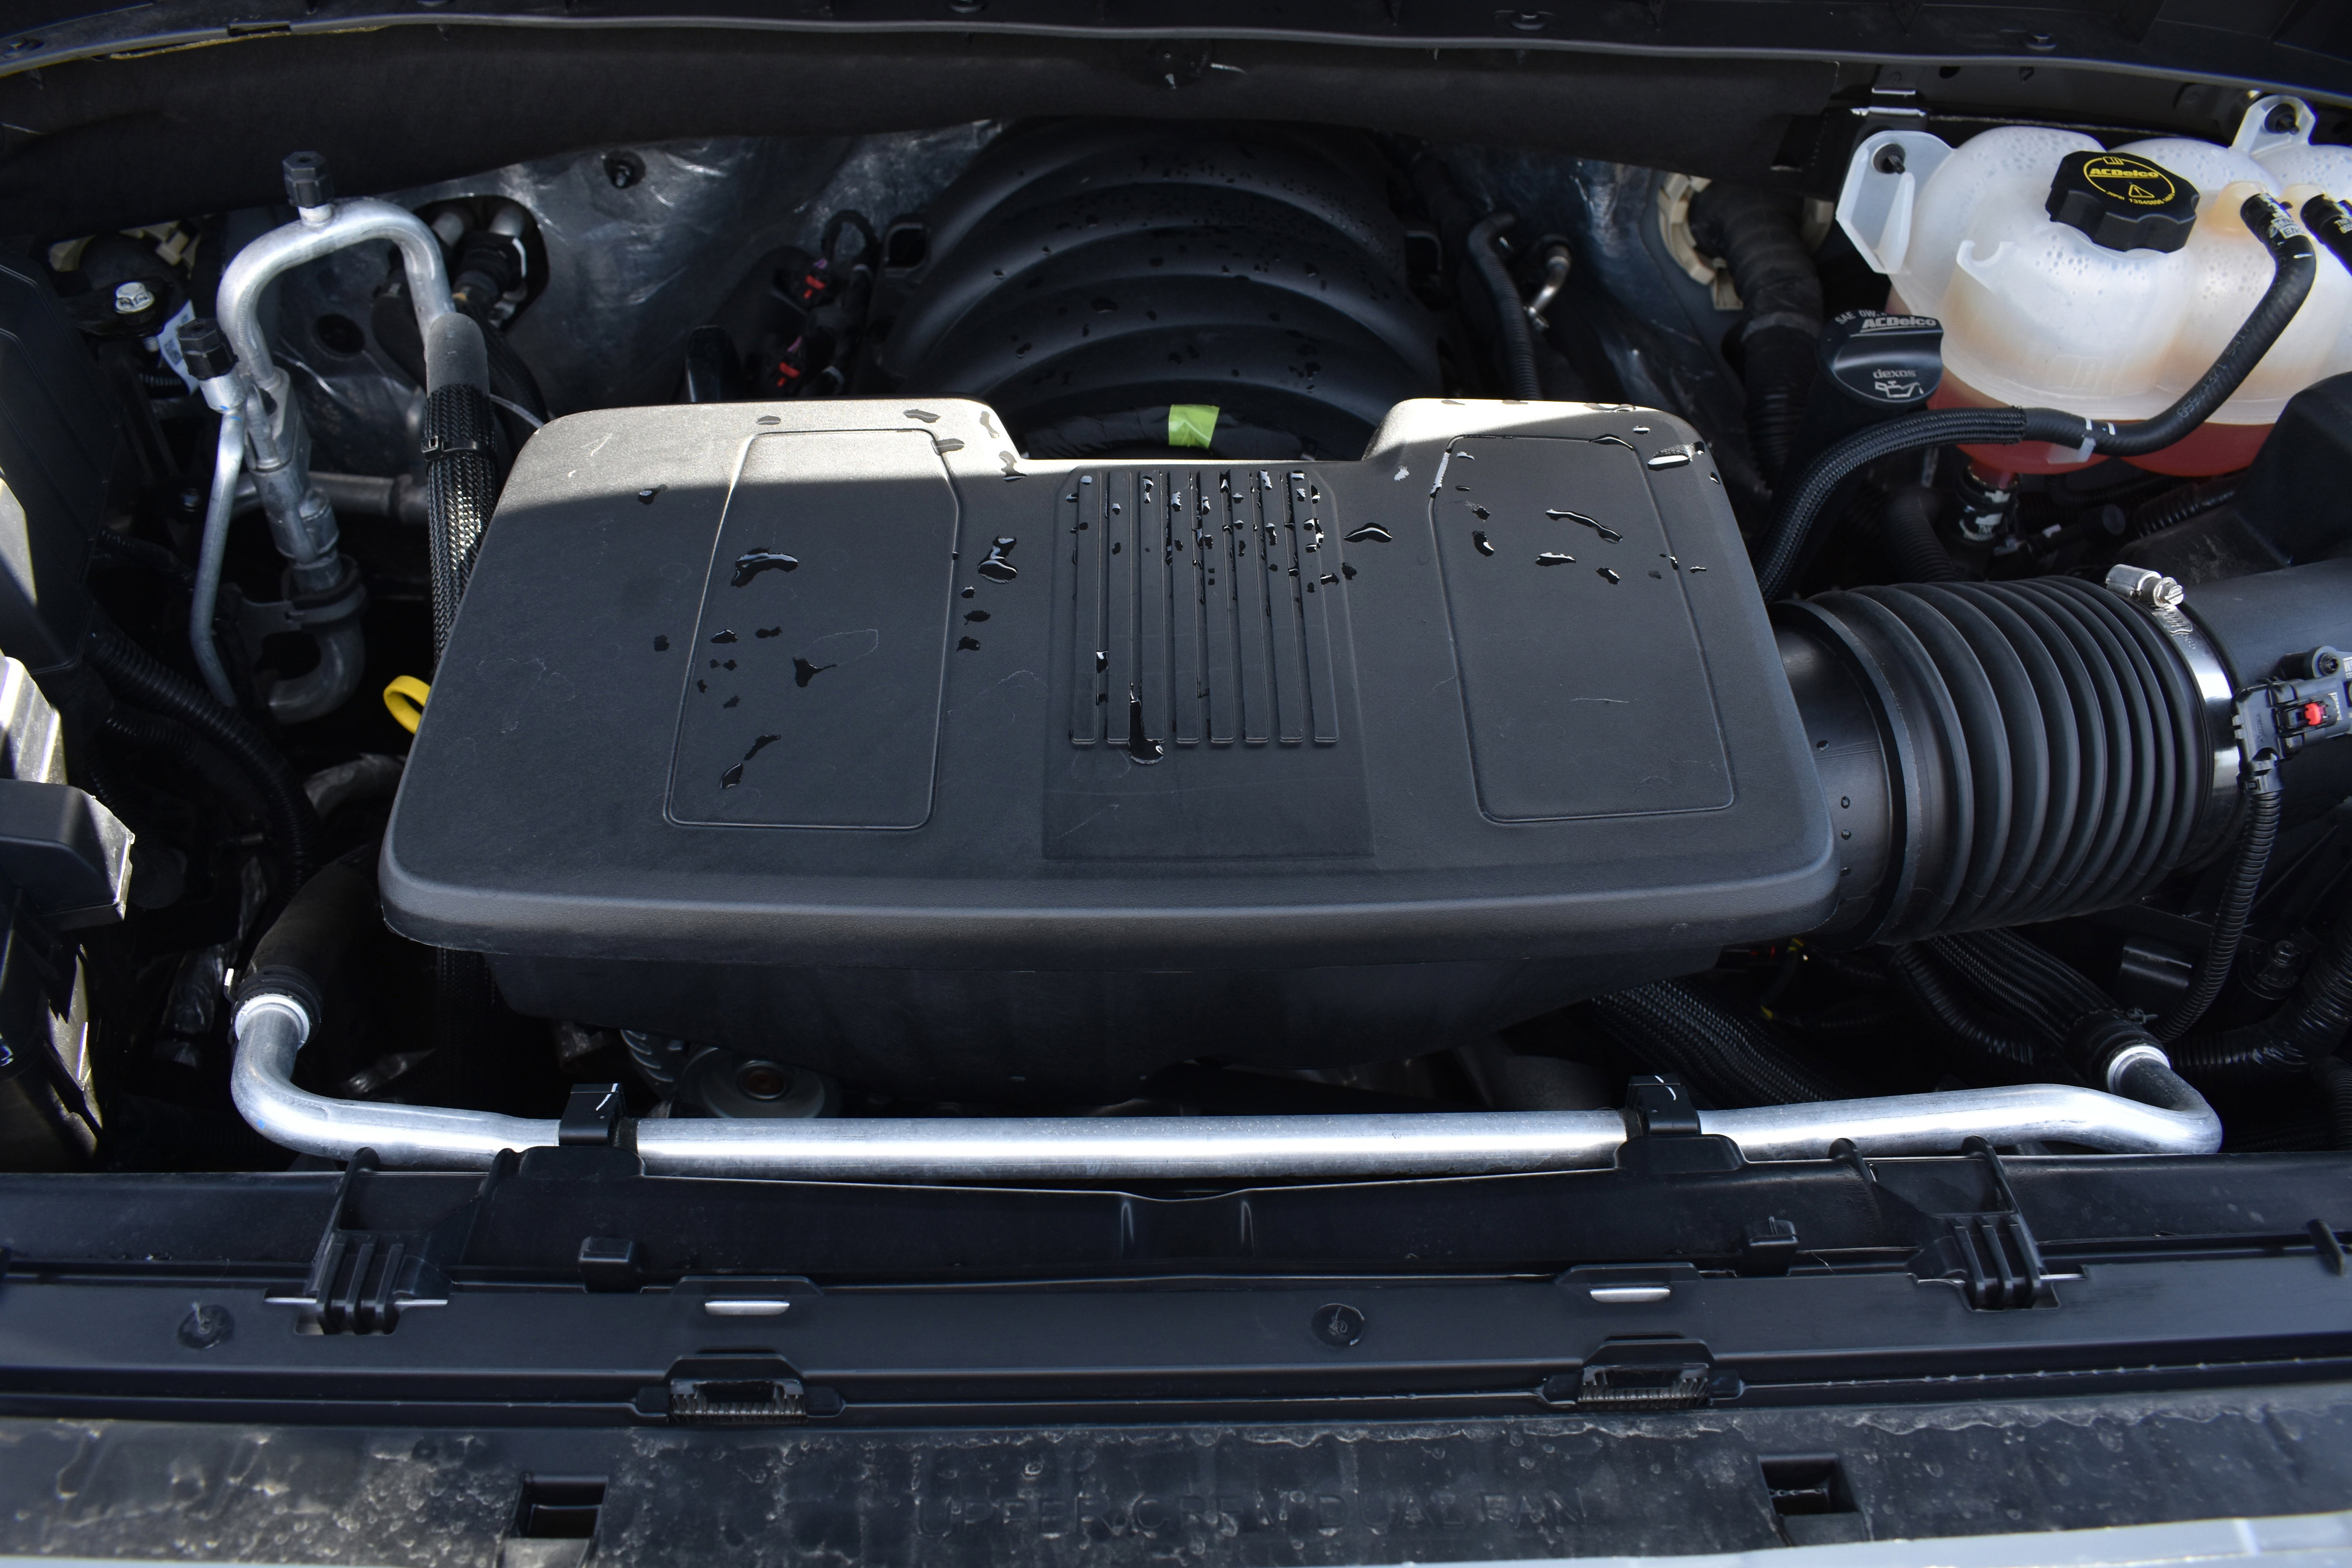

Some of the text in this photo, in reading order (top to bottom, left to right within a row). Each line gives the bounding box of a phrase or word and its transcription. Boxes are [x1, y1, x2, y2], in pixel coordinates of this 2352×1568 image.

[2089, 168, 2159, 178] ACDelco
[1835, 311, 1856, 325] SAE
[1861, 316, 1937, 329] ACDelco
[1873, 369, 1917, 379] dexos
[916, 1495, 1114, 1537] UPPER
[1314, 1491, 1466, 1530] DUAL
[1479, 1488, 1588, 1528] FAN
